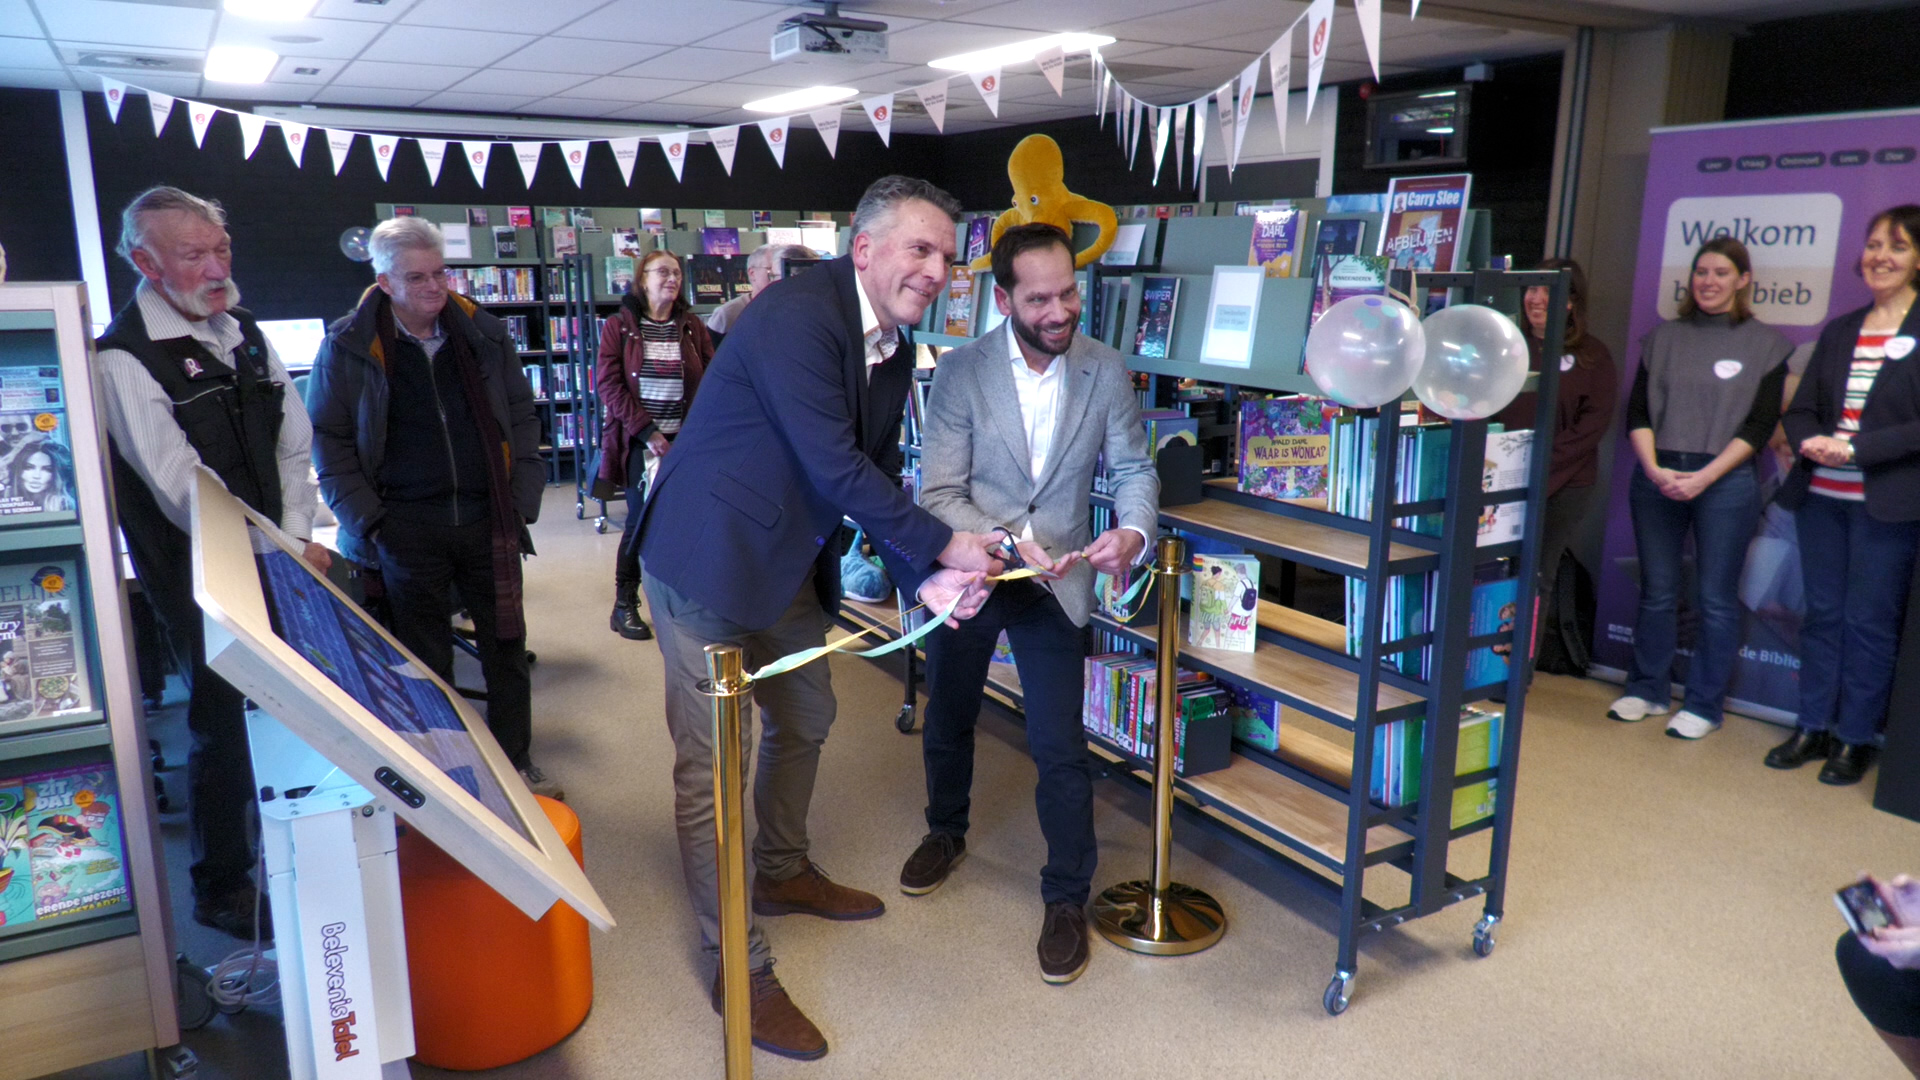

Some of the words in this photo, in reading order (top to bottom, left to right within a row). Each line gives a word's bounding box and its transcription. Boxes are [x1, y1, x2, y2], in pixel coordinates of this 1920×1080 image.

[1408, 192, 1436, 207] Carry
[1436, 190, 1460, 206] Slee
[1261, 225, 1286, 239] DAHL
[1681, 218, 1816, 246] Welkom
[1752, 281, 1811, 305] bieb
[1254, 445, 1280, 460] WAAR
[1281, 448, 1289, 458] IS
[1291, 445, 1327, 459] WONKA?
[1738, 644, 1757, 661] de
[36, 791, 73, 810] DAT
